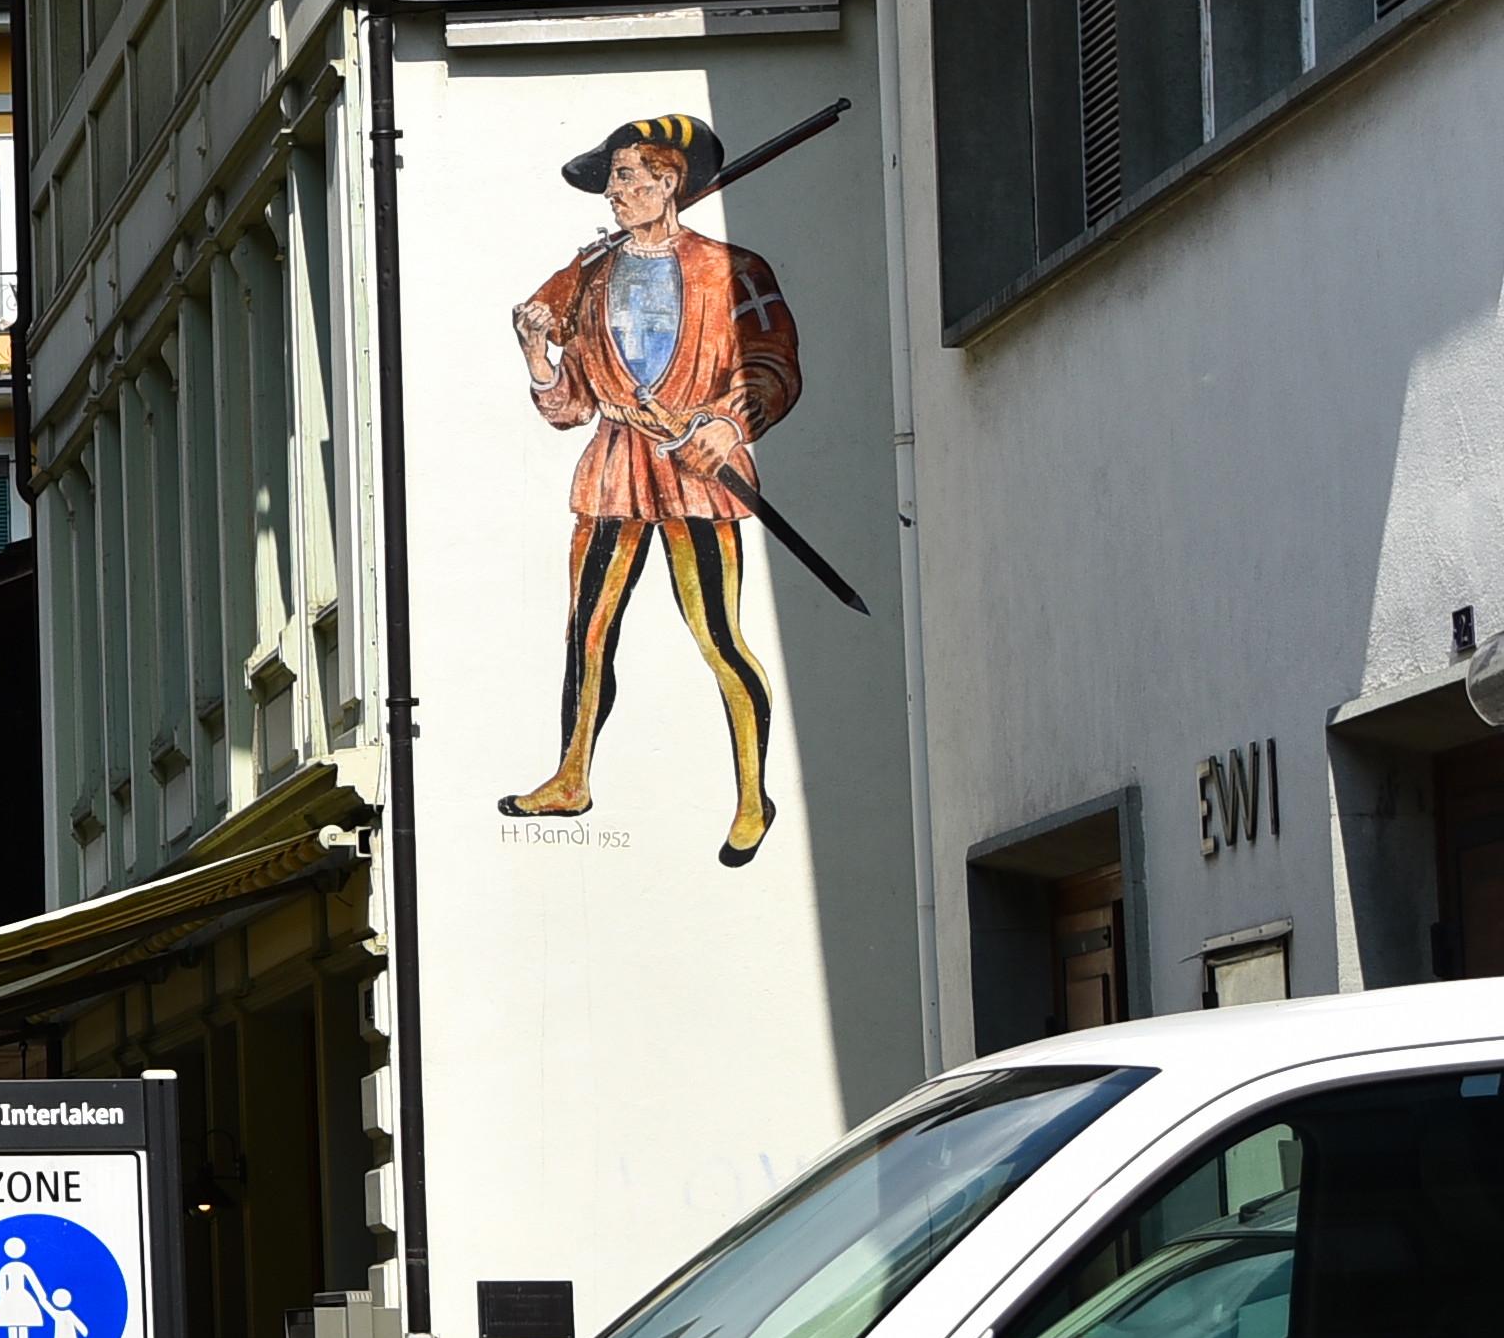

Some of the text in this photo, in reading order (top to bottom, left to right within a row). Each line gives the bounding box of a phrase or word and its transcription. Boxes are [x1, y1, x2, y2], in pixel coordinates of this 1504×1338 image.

[1196, 736, 1280, 857] EWI
[525, 820, 591, 846] Bandi
[597, 830, 631, 849] 1952
[0, 1100, 124, 1128] Interlaken
